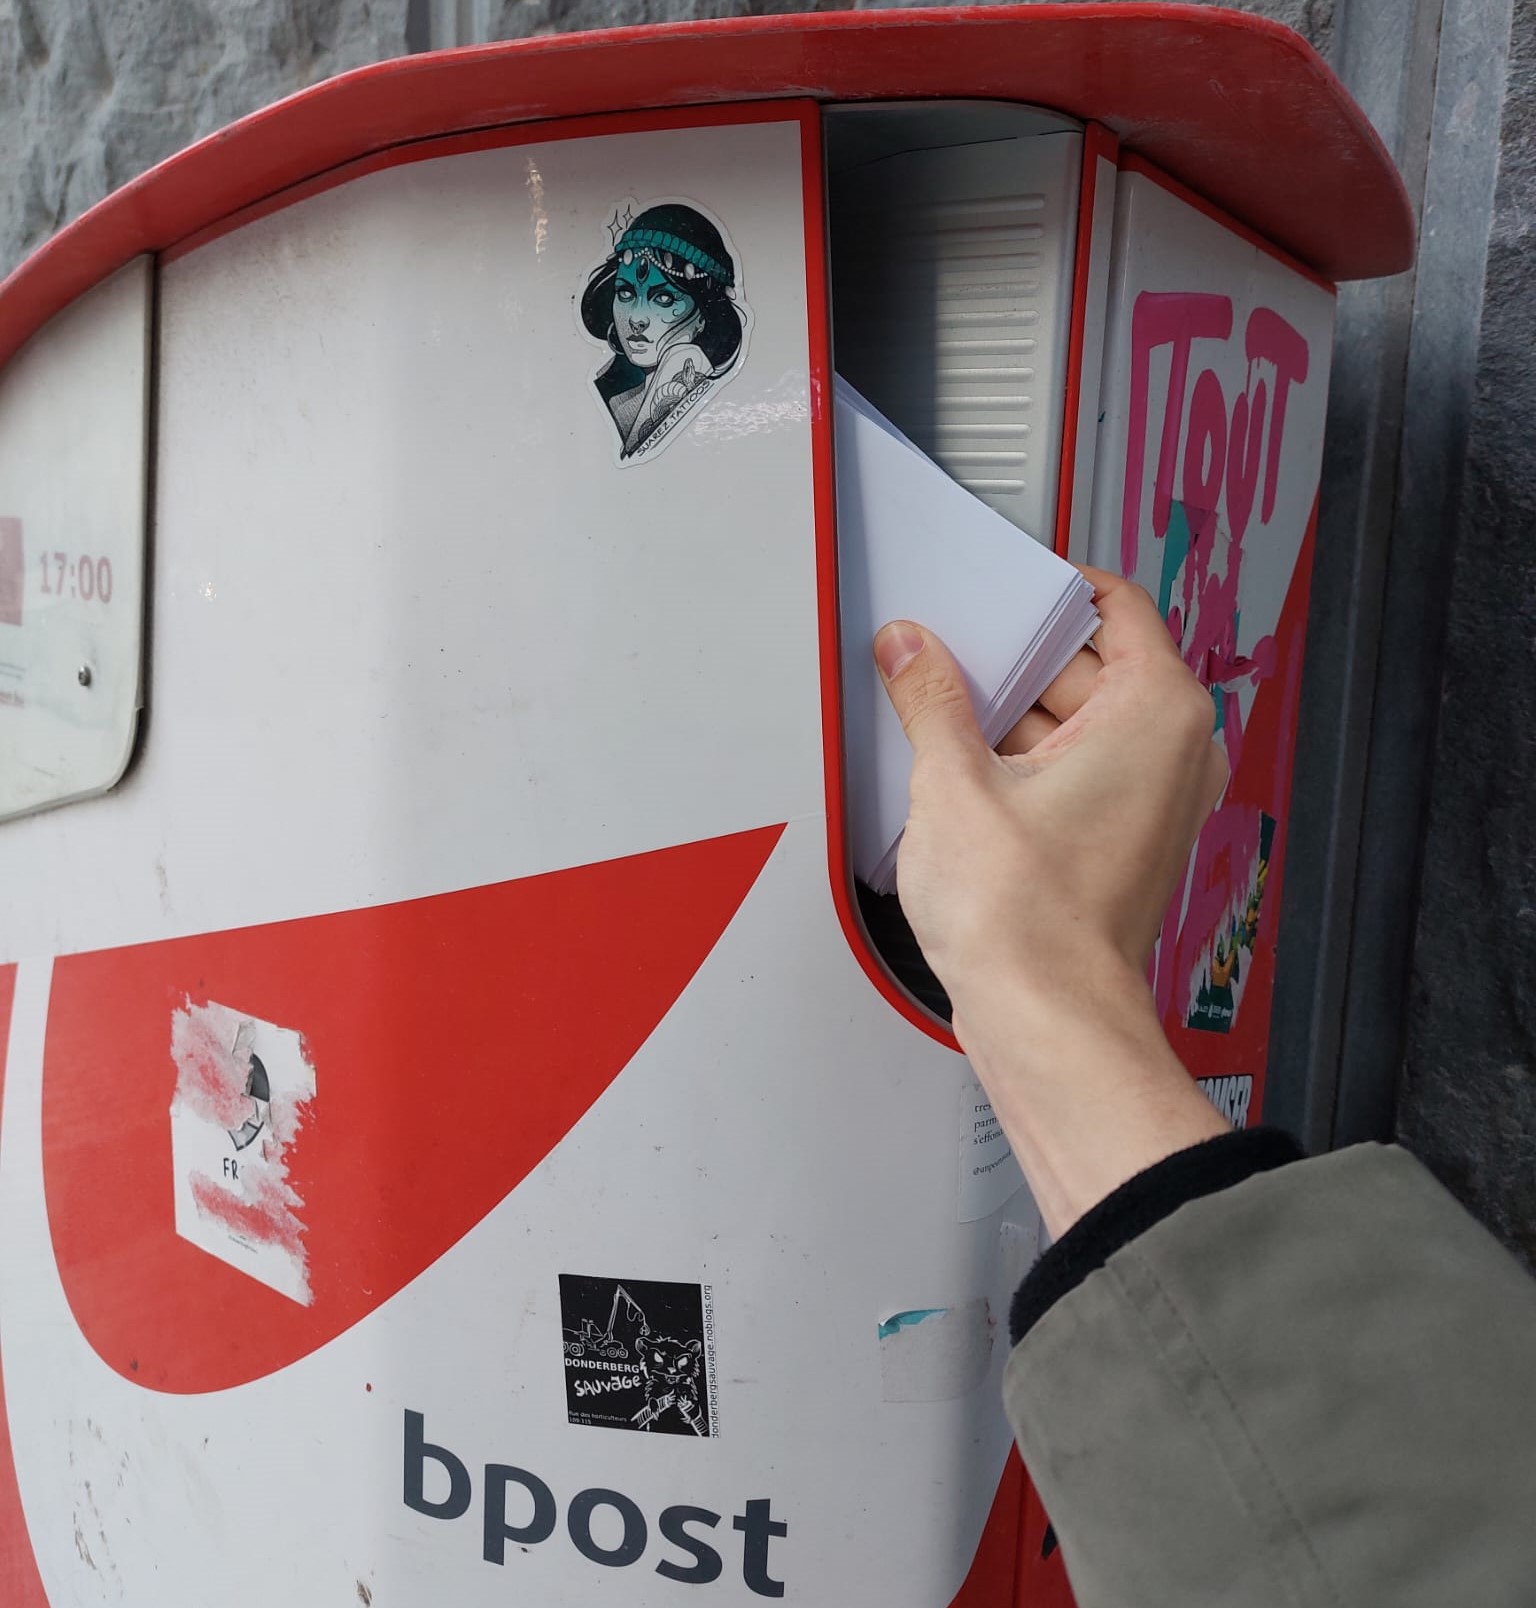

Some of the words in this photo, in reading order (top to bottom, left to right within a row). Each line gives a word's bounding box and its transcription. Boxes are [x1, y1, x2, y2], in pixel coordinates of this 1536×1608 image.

[40, 552, 112, 603] 17:00
[565, 1358, 640, 1373] DONDERBERG
[403, 1408, 788, 1598] bpost
